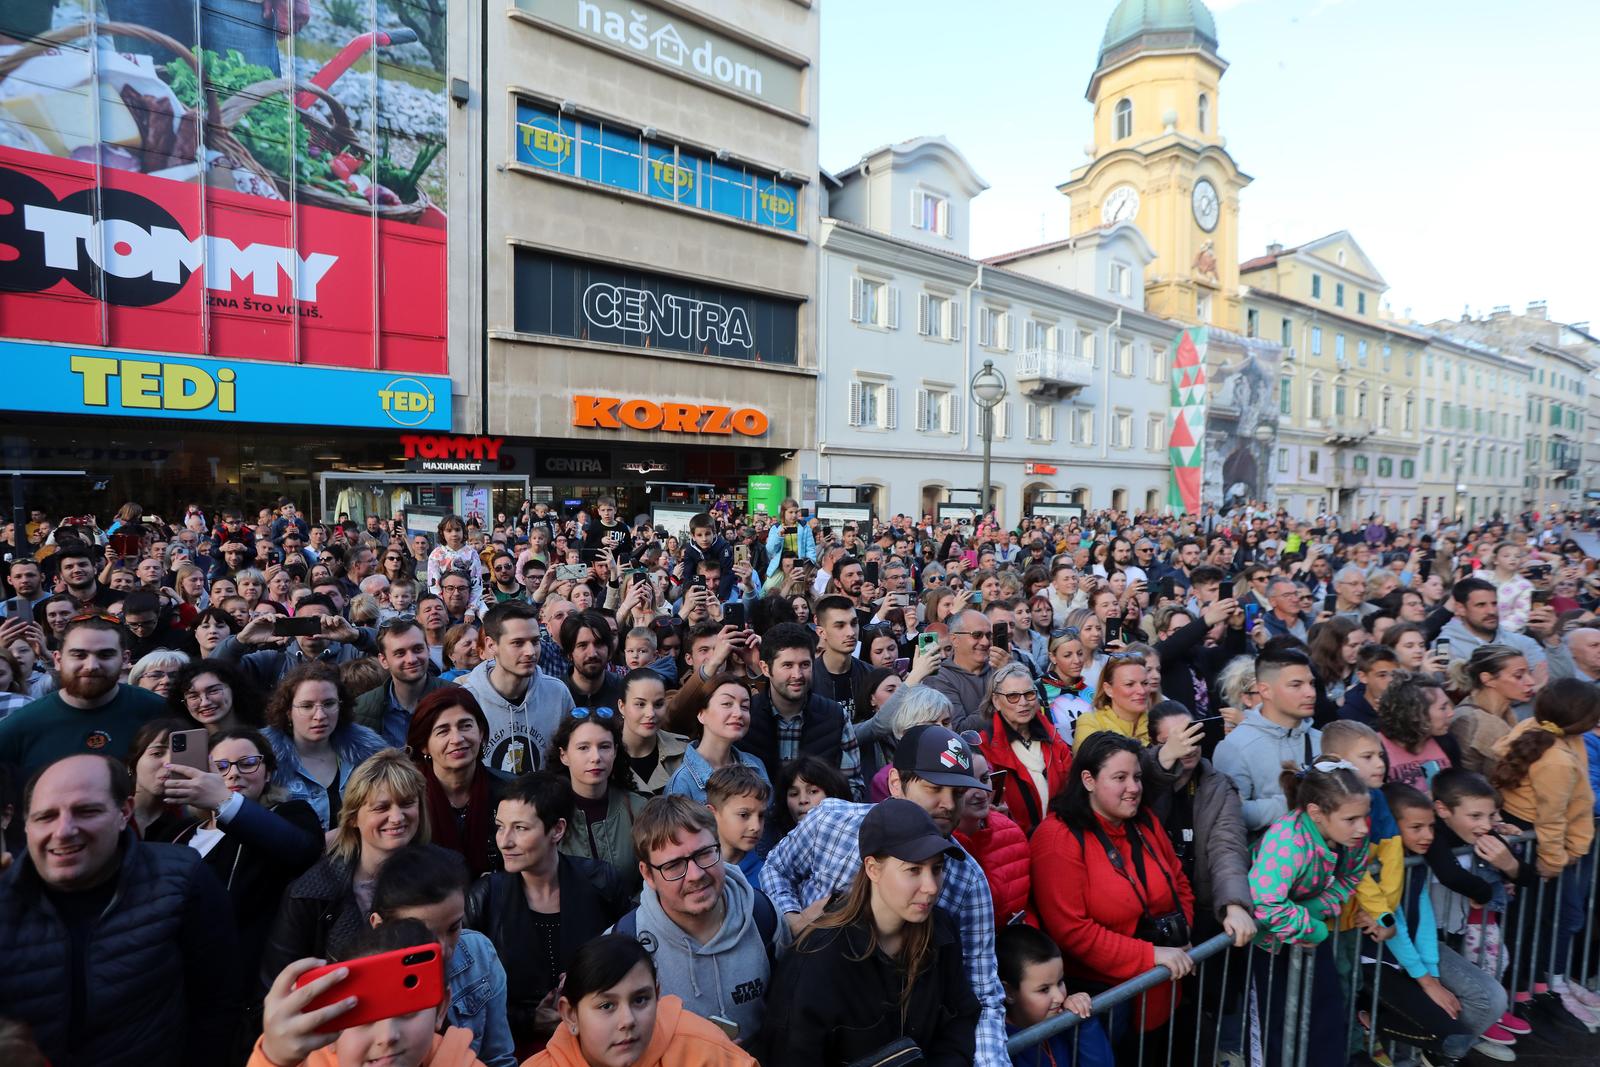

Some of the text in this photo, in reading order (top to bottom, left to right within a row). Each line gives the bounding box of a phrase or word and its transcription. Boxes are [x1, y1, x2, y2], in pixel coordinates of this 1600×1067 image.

[578, 0, 762, 94] naš dom
[519, 125, 571, 158] TEDi
[651, 161, 693, 188] TEDi
[759, 192, 794, 217] TEDi
[24, 204, 339, 302] TOMMY
[243, 297, 273, 312] ŠTO
[583, 282, 753, 348] CENTRA
[70, 355, 237, 413] TEDi
[378, 390, 435, 413] TEDi
[572, 394, 769, 436] KORZO
[400, 434, 504, 460] TOMMY
[422, 462, 482, 471] MAXIMARKET
[544, 457, 602, 472] CENTRA
[731, 986, 763, 1005] WARS
[735, 977, 763, 993] STAR
